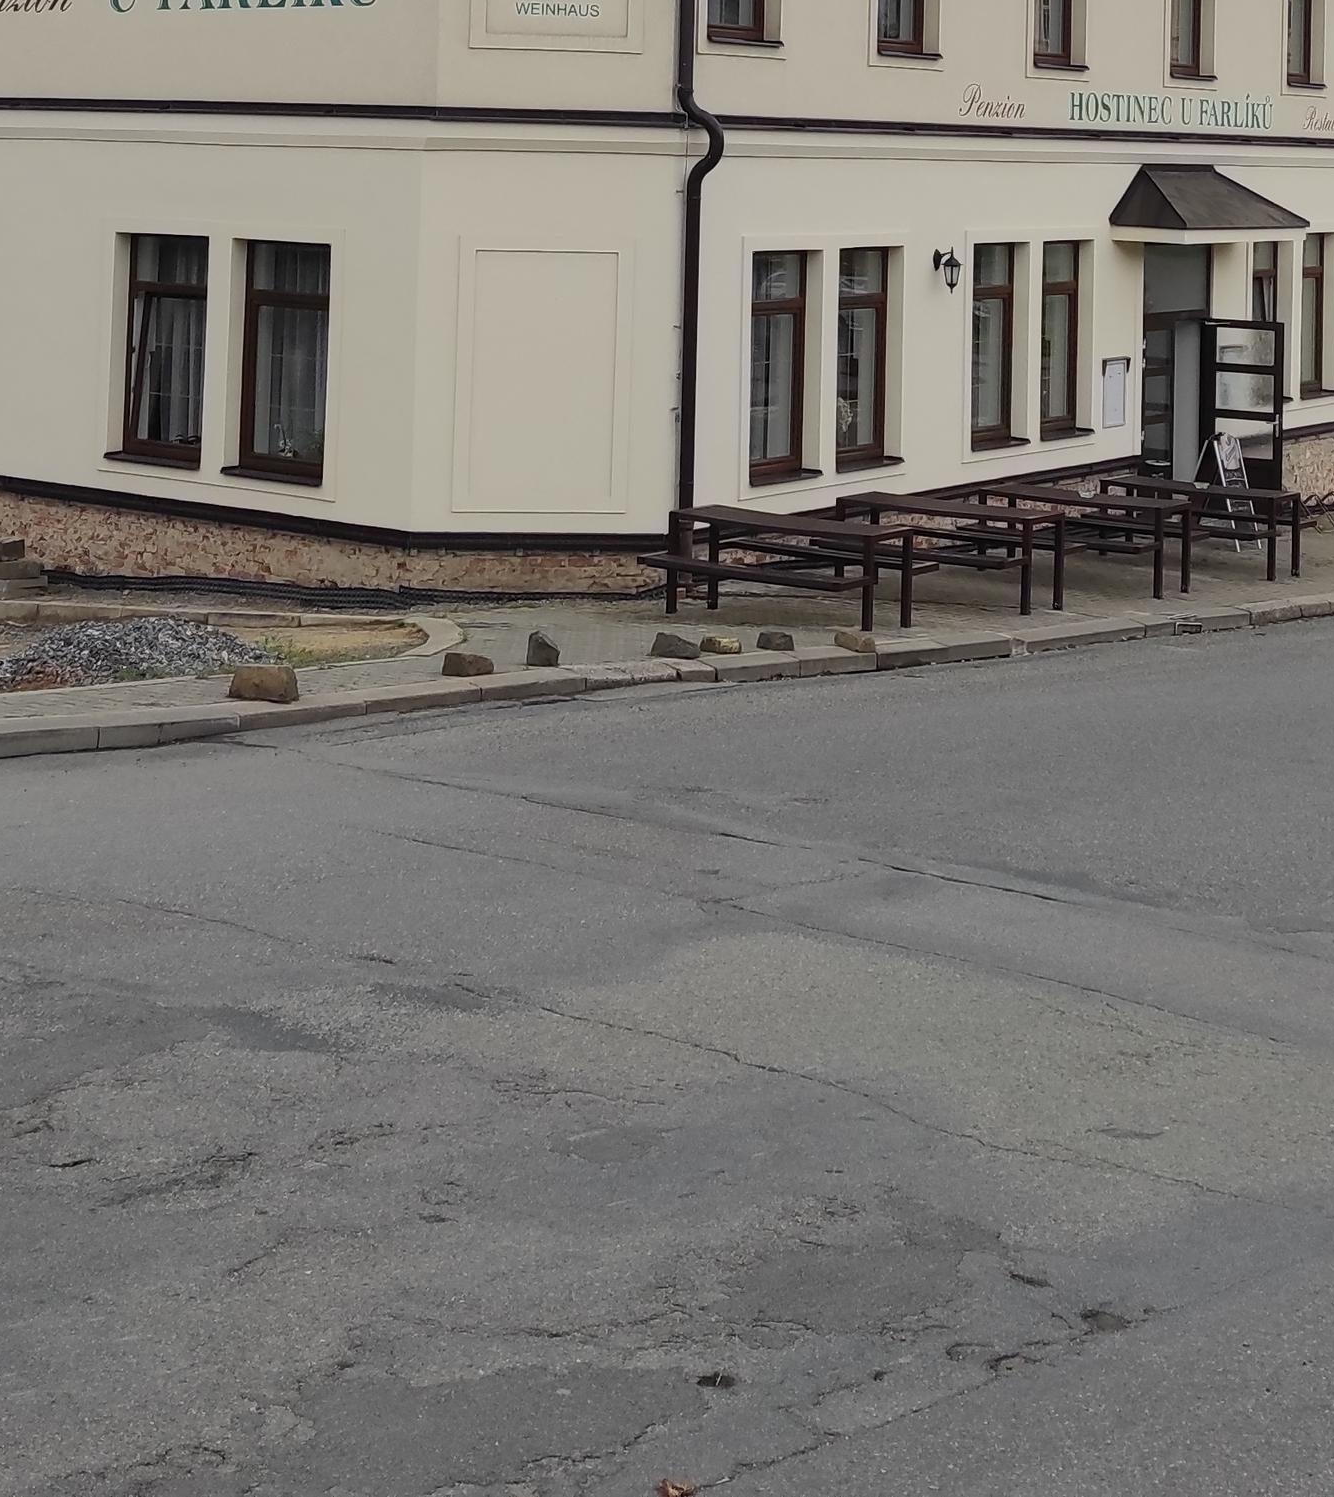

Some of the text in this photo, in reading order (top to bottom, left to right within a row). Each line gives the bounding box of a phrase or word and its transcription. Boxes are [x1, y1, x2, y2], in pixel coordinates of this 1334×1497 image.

[515, 1, 600, 17] WEINHAUS
[958, 82, 1026, 120] Penzion
[1069, 91, 1172, 125] HOSTINEC
[1180, 97, 1192, 126] U
[1198, 94, 1273, 130] FARLÍKŮ
